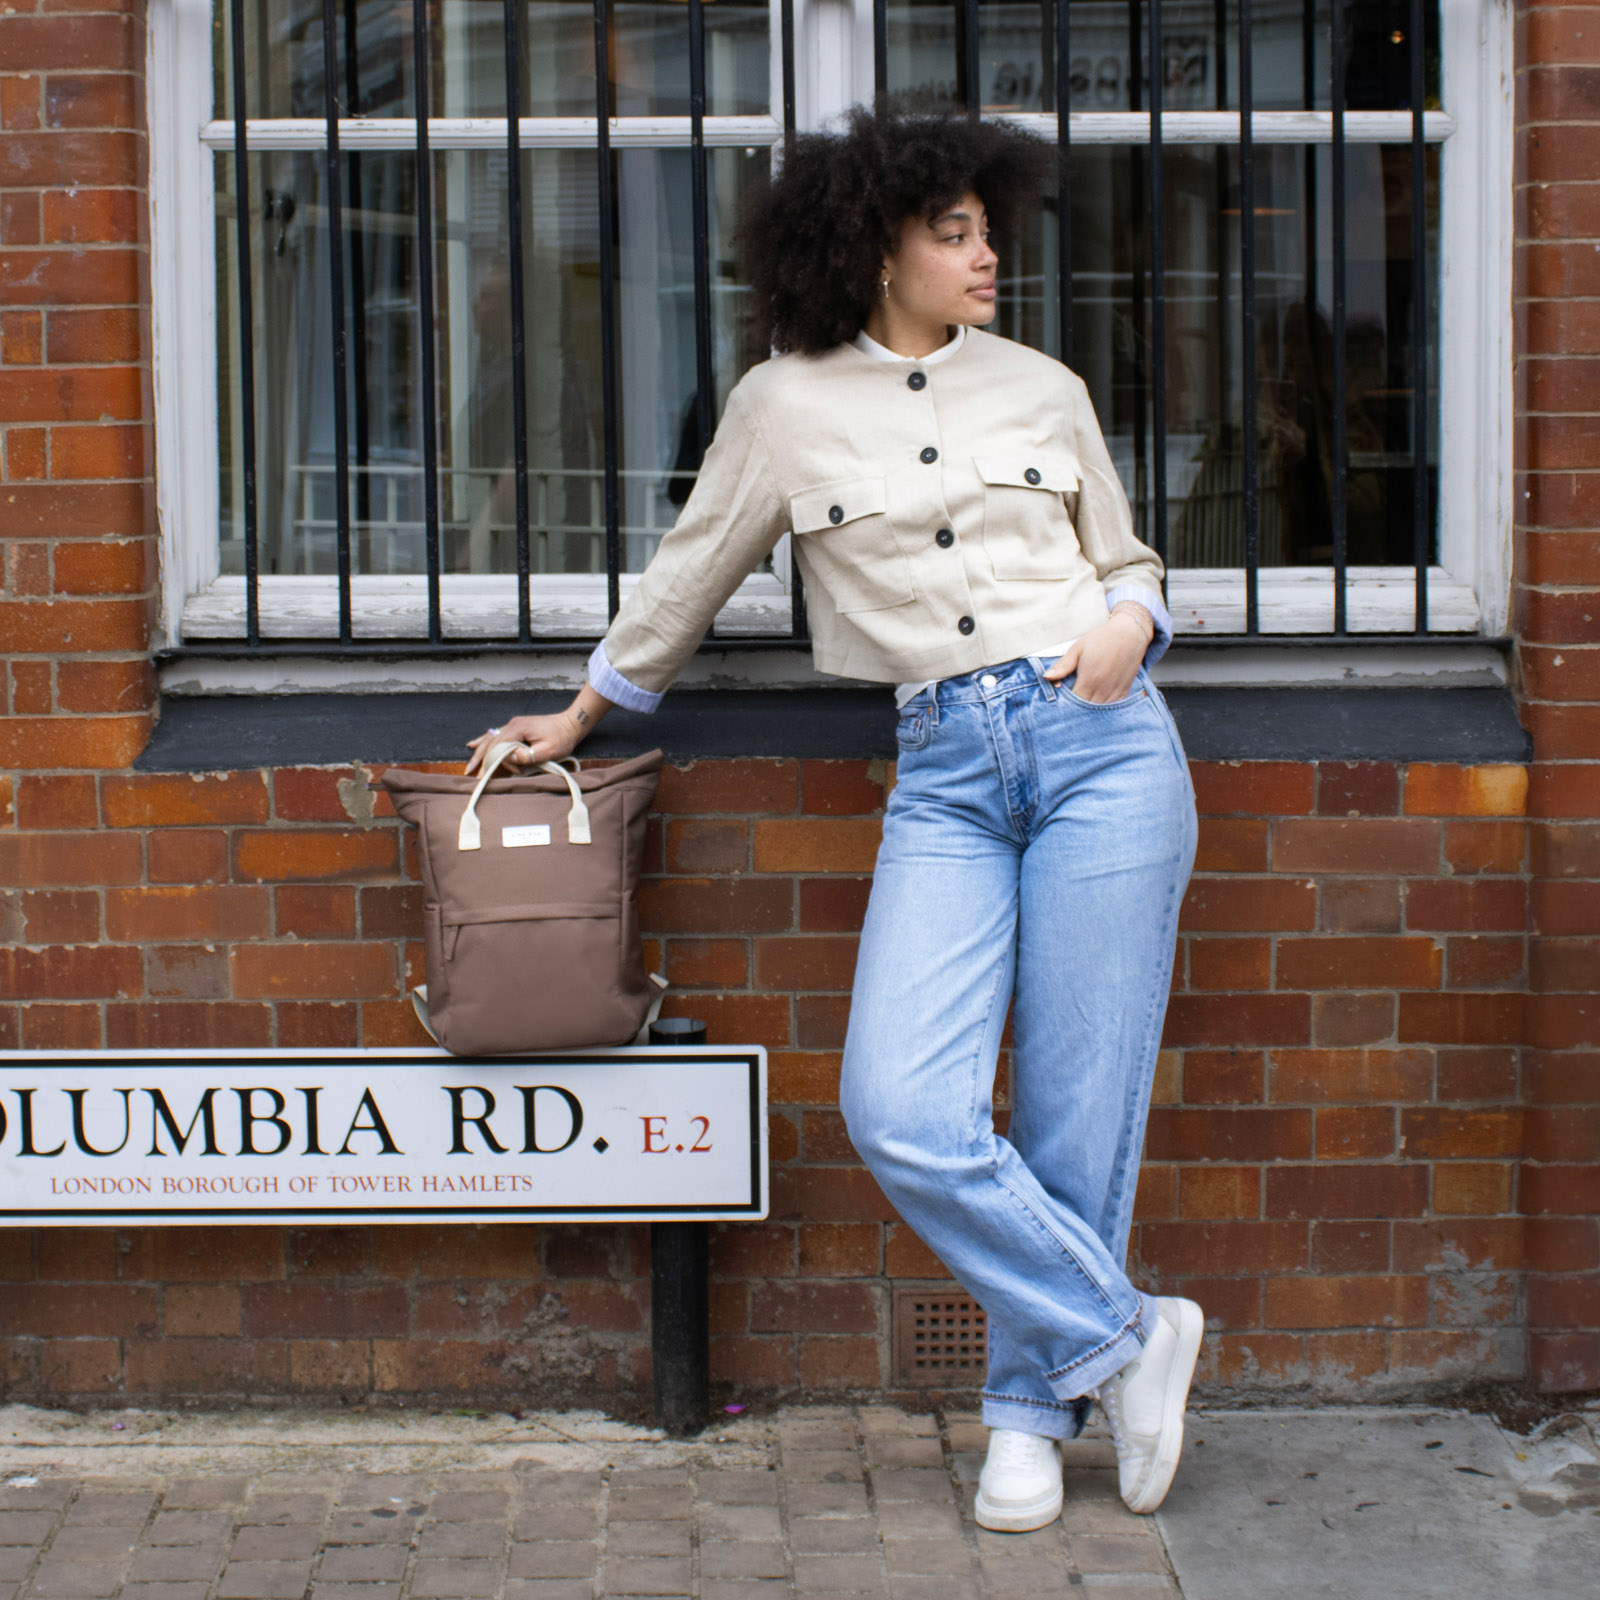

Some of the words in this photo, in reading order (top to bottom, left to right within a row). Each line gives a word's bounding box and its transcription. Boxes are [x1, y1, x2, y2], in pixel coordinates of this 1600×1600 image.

[0, 1086, 405, 1157] LUMBIA
[441, 1085, 609, 1154] RD.
[639, 1116, 713, 1153] E.2
[51, 1177, 152, 1194] LONDON
[163, 1176, 279, 1194] BOROUGH
[289, 1176, 319, 1193] OF
[327, 1176, 412, 1193] TOWER
[422, 1175, 533, 1192] HAMLETS
